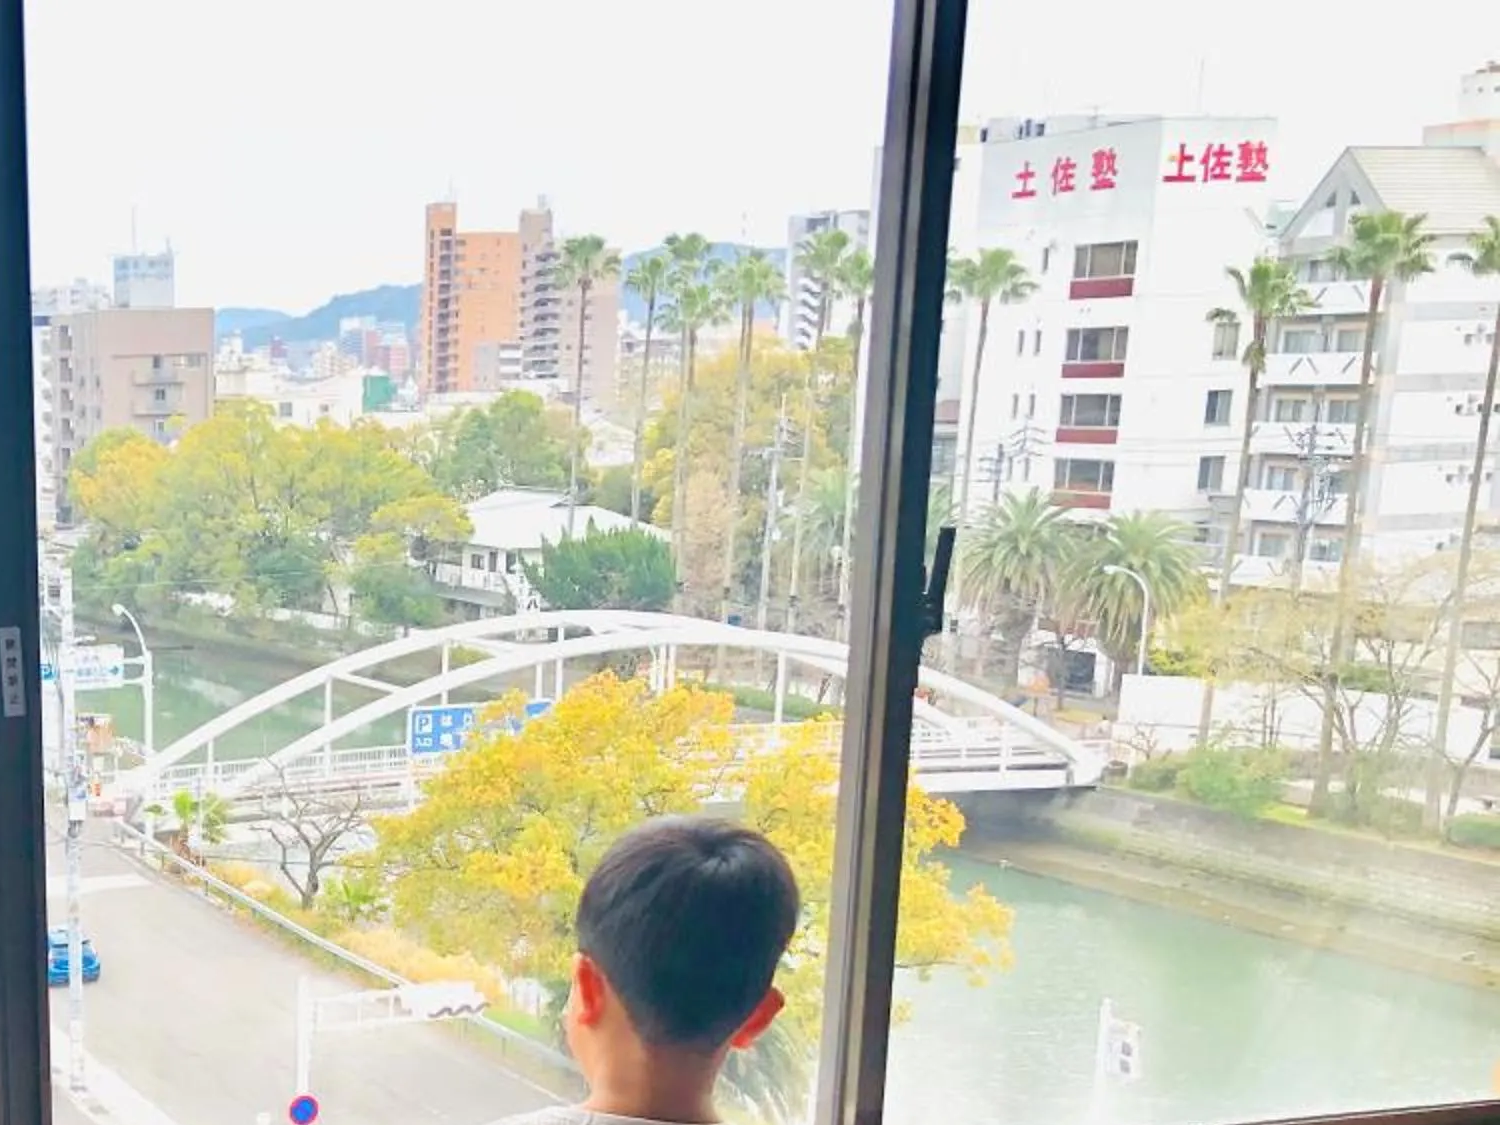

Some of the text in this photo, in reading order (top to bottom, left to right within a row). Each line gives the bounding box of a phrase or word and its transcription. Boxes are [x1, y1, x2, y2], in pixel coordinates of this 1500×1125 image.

[1011, 148, 1118, 199] 土佐塾
[1163, 140, 1270, 183] 土佐塾
